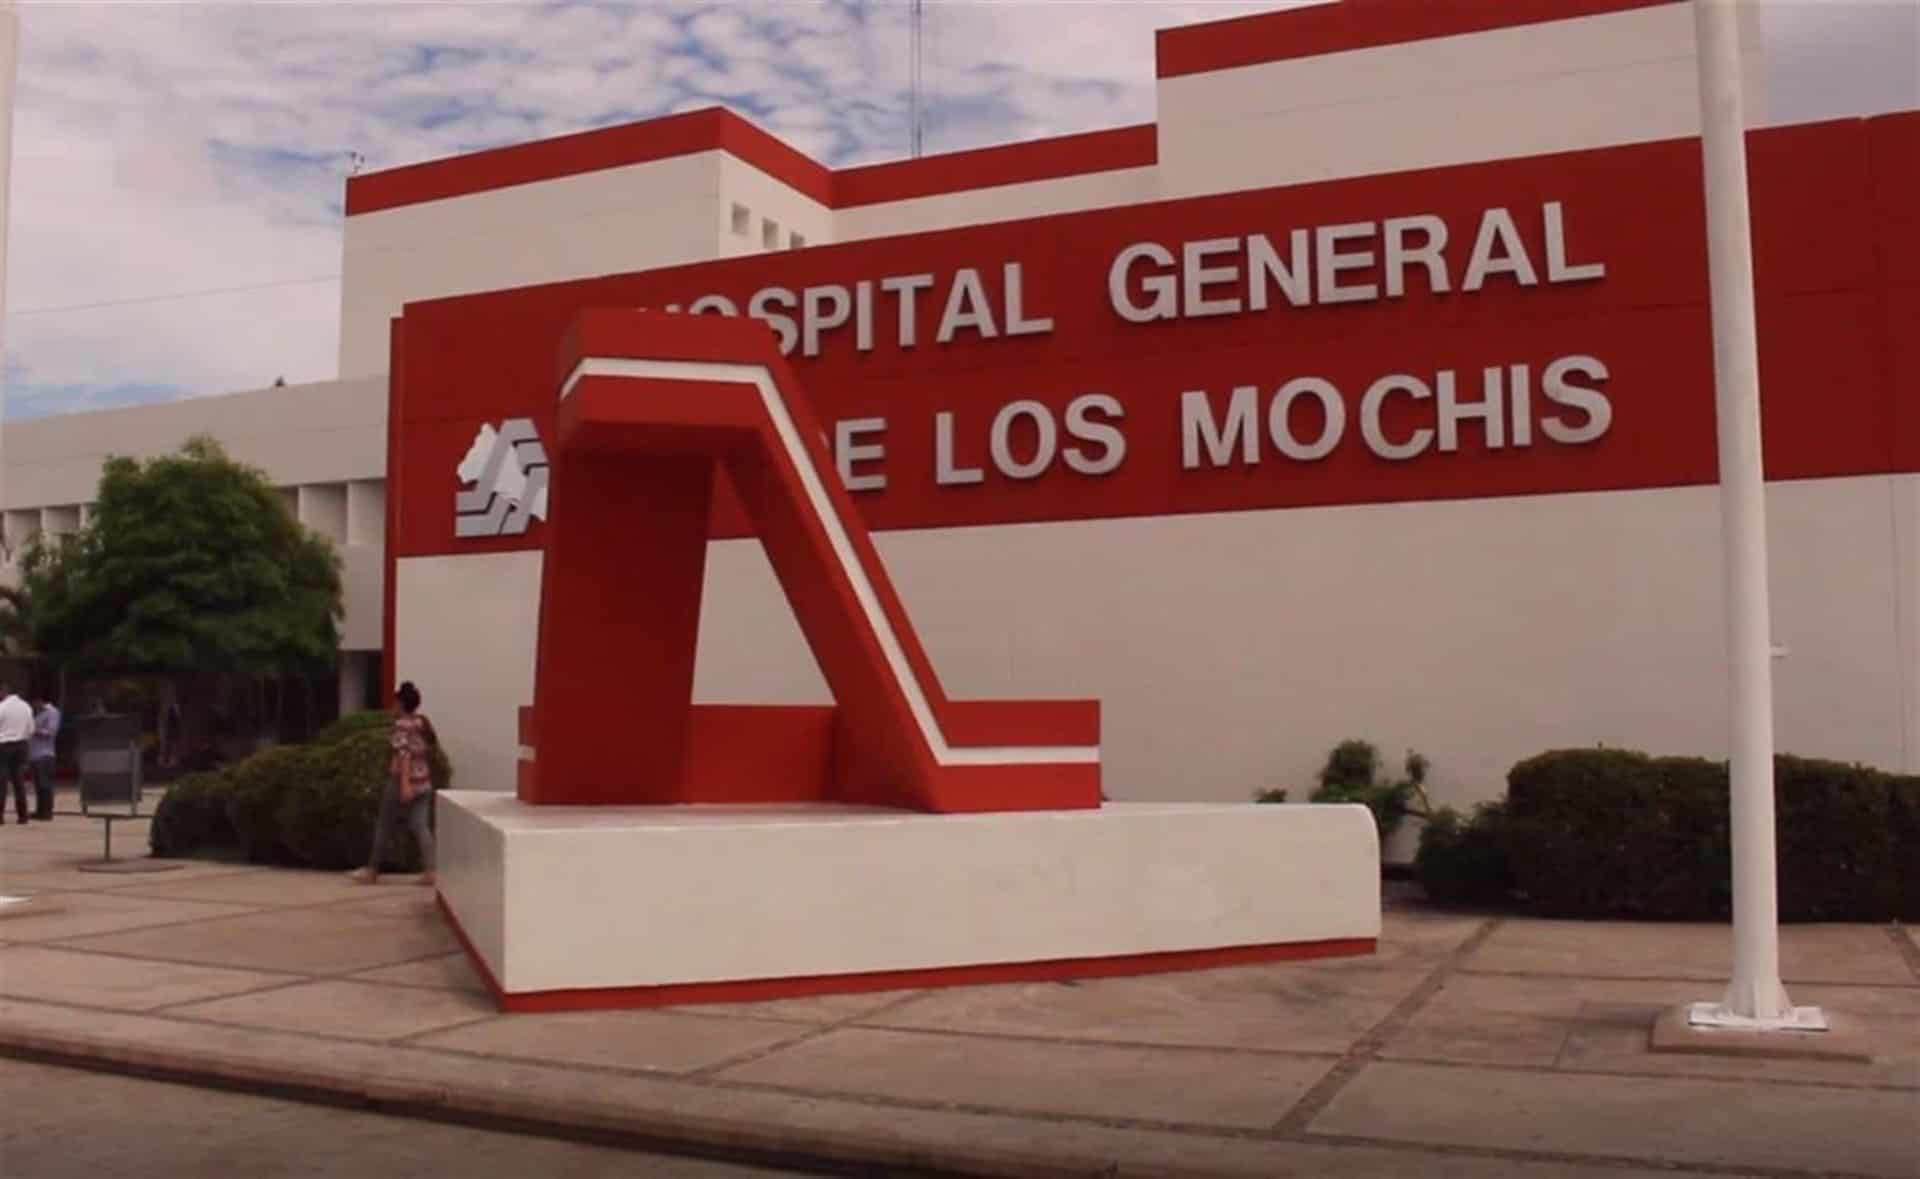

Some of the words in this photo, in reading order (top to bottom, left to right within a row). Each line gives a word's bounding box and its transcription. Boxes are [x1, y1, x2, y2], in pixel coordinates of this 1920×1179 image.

[636, 263, 1054, 357] SPITAL
[1108, 201, 1605, 322] GENERAL
[818, 417, 887, 490] E
[935, 393, 1126, 484] LOS
[1181, 355, 1612, 468] MOCHIS
